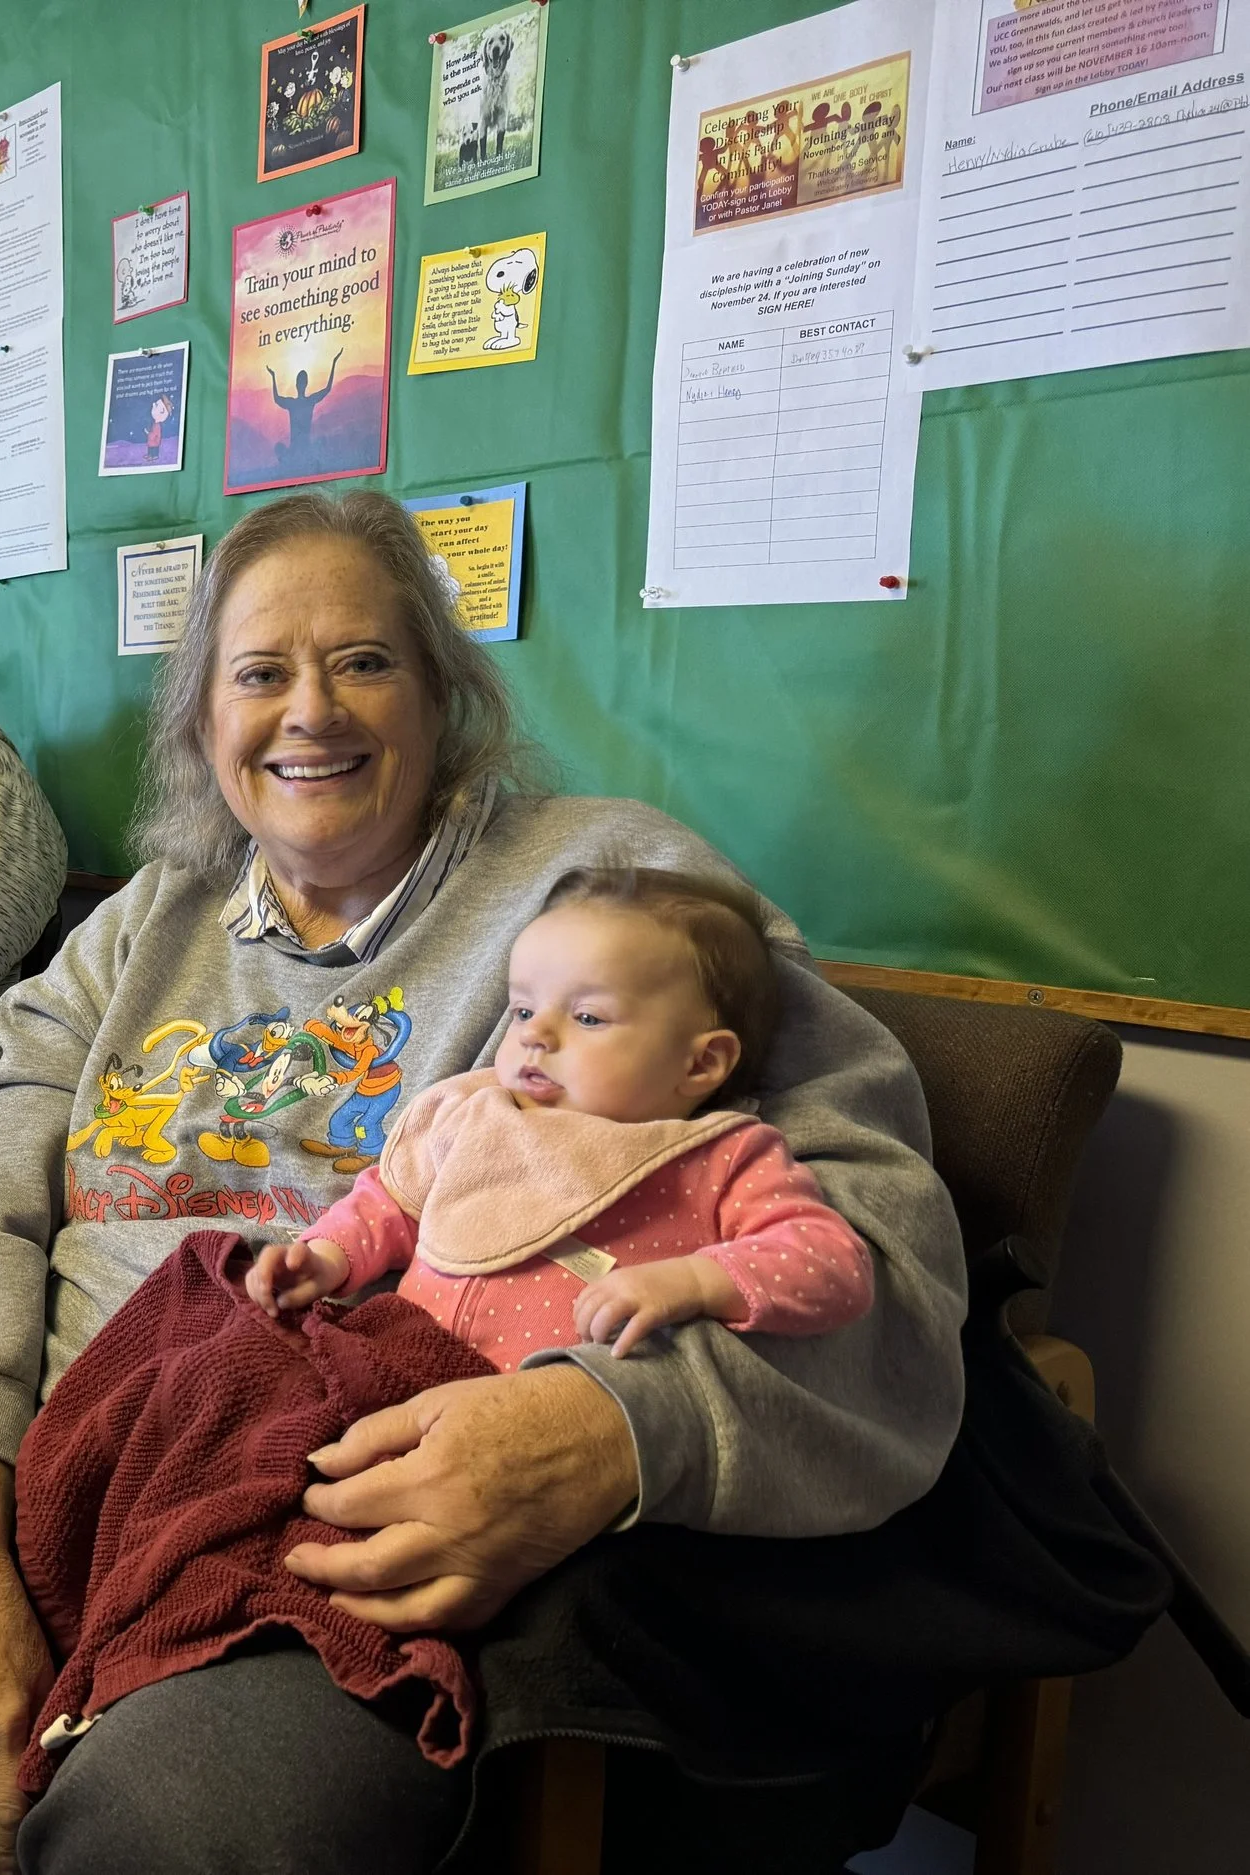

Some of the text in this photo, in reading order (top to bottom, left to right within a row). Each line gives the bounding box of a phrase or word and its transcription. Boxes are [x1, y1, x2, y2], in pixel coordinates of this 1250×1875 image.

[446, 51, 477, 69] How deep
[450, 69, 461, 78] the
[462, 58, 481, 73] mud?
[986, 84, 1002, 94] Our
[1004, 78, 1022, 90] next
[1024, 72, 1045, 84] class
[1047, 66, 1063, 78] will
[1065, 63, 1076, 73] be
[1078, 49, 1133, 70] NOVEMBER
[443, 97, 456, 106] who
[458, 91, 469, 102] you
[445, 80, 471, 96] Depends
[811, 88, 835, 101] WE ARE
[1089, 72, 1245, 116] Phone/Email Address
[705, 100, 800, 135] Celebrating Your
[854, 115, 895, 134] Sunday
[715, 121, 784, 149] Discipleship
[803, 130, 895, 160] November 24 10:00 am
[944, 136, 976, 151] Name:
[730, 148, 751, 162] this
[754, 140, 782, 157] Faith
[712, 156, 782, 183] Community!
[808, 161, 856, 180] Thanksgiving
[858, 154, 887, 167] Service
[700, 174, 795, 203] Confirm your participation
[702, 185, 792, 213] TODAY-sign up in Lobby
[718, 208, 733, 220] with
[735, 205, 760, 216] Pastor
[761, 199, 783, 211] Janet
[244, 246, 376, 294] Train your mind to
[431, 267, 450, 276] Always
[451, 263, 469, 272] believe
[711, 275, 724, 284] We
[726, 272, 741, 280] are
[742, 267, 773, 279] having
[784, 254, 836, 271] celebration
[838, 250, 848, 261] of
[850, 248, 869, 258] new
[428, 269, 483, 285] something wonderful
[699, 282, 751, 299] discipleship
[753, 278, 773, 289] with
[868, 260, 881, 269] on
[240, 270, 380, 324] see something good
[710, 275, 867, 310] November 24. If you are interested
[757, 299, 815, 315] SIGN HERE!
[258, 312, 355, 347] in everything.
[799, 318, 876, 339] BEST CONTACT
[718, 339, 745, 350] NAME
[431, 524, 489, 537] start your day
[456, 537, 479, 545] affect
[447, 551, 466, 559] your
[492, 544, 508, 553] day!
[163, 564, 181, 572] AFRAID
